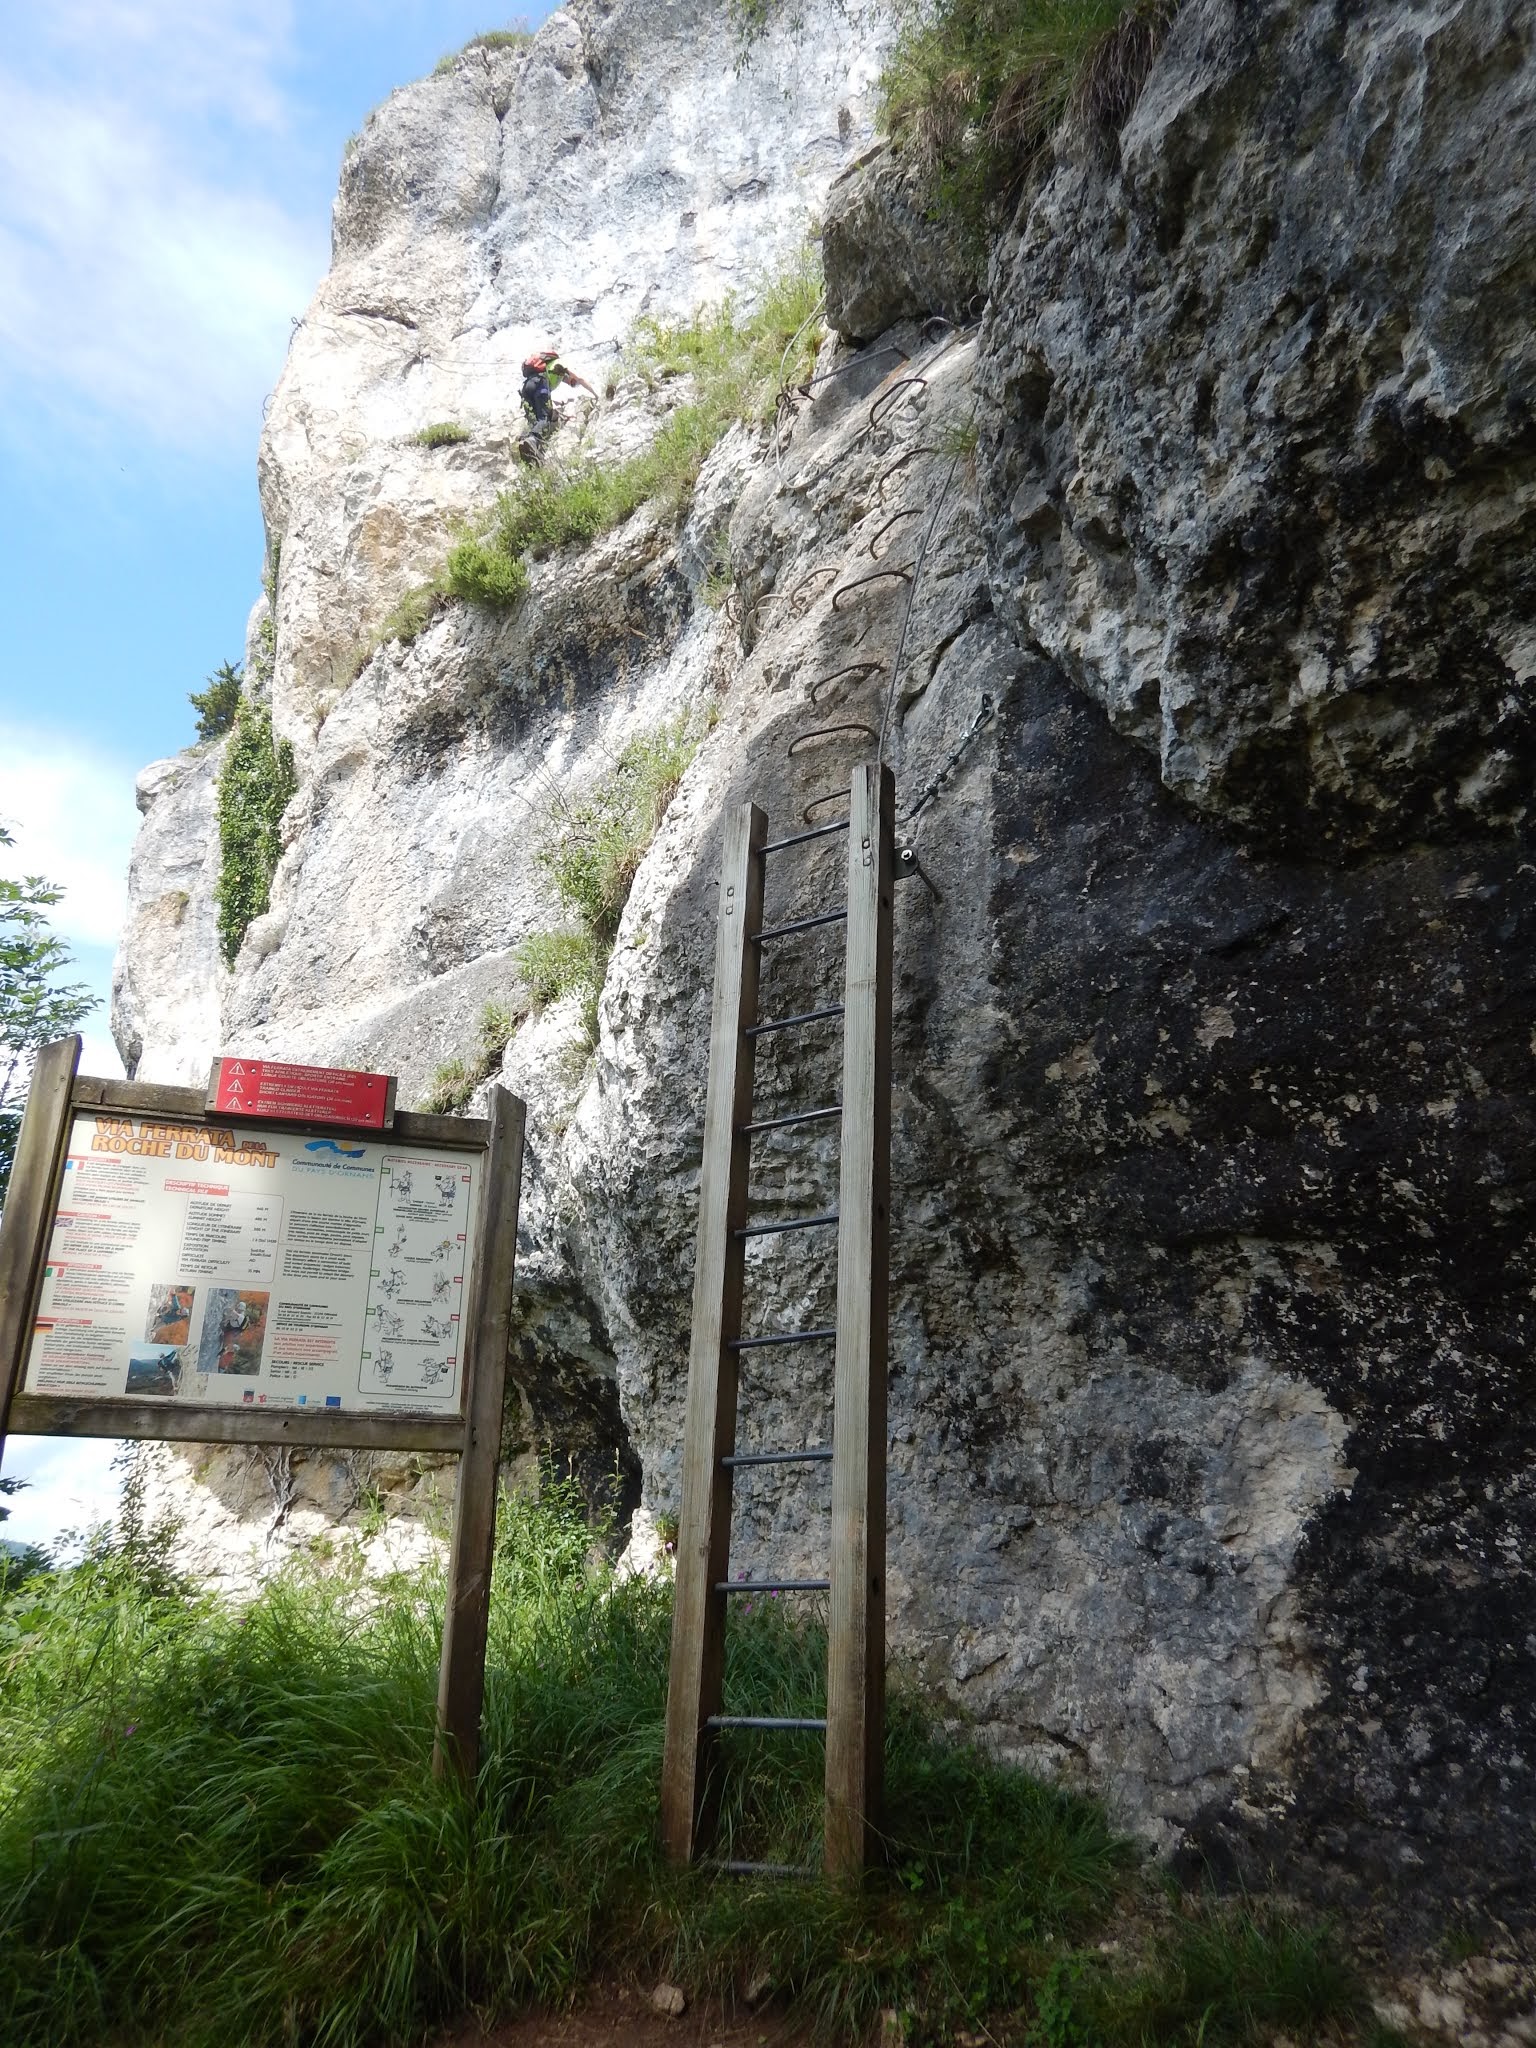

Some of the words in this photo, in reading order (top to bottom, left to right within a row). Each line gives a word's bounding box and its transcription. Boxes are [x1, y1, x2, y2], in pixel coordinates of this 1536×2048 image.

[94, 1116, 135, 1138] VIA
[139, 1121, 237, 1148] FERRATA
[91, 1134, 172, 1158] ROCHE
[175, 1143, 210, 1162] DU
[213, 1146, 280, 1169] MONT
[292, 1159, 332, 1168] Communauté
[342, 1164, 375, 1172] Communes
